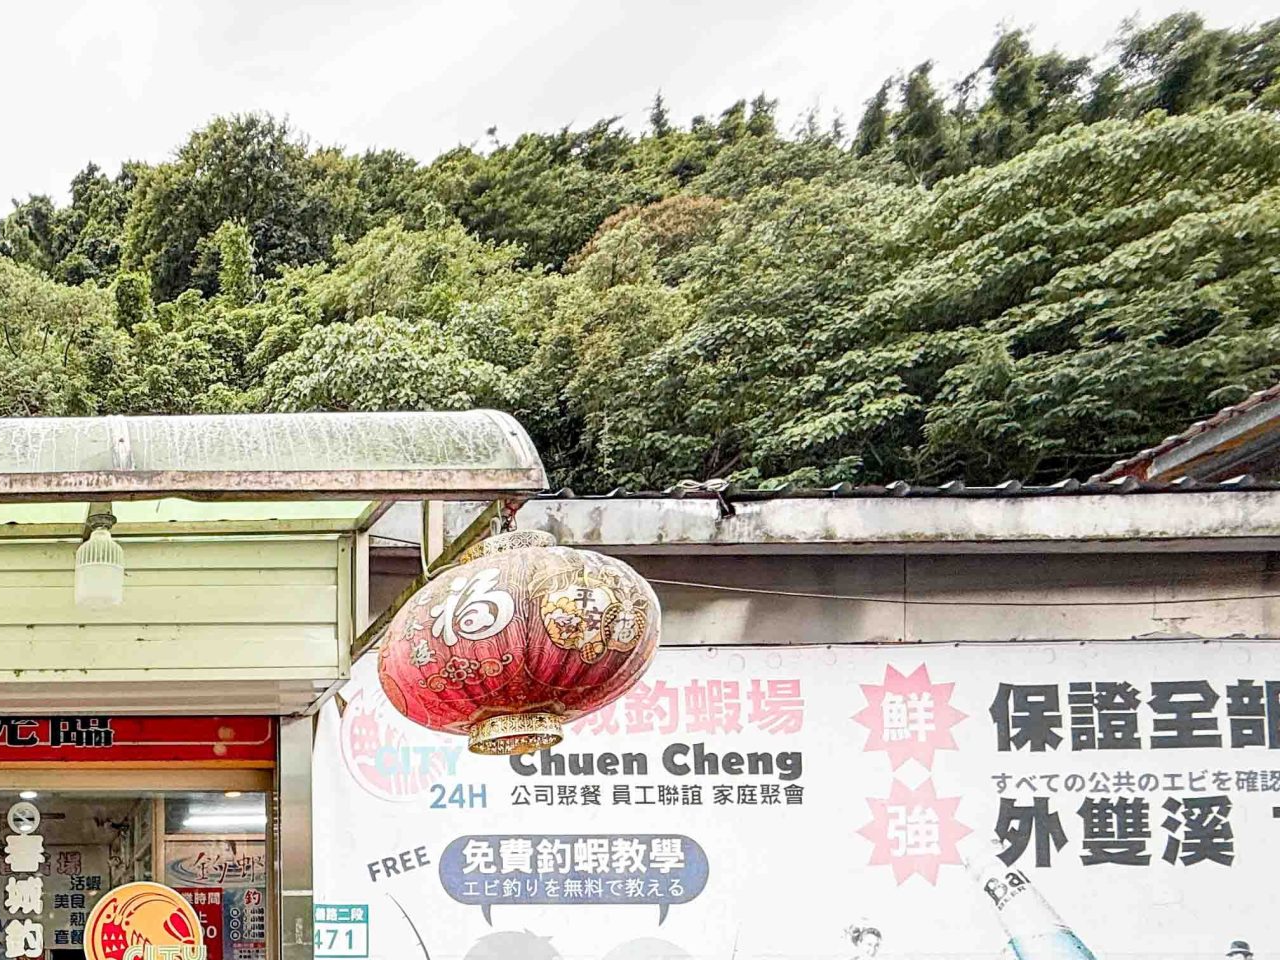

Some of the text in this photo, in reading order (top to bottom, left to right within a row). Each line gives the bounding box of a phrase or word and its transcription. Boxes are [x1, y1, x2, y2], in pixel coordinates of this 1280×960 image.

[430, 567, 515, 647] 福
[880, 692, 936, 743] 鮮
[374, 746, 463, 777] CITY
[509, 743, 803, 782] Chuen Cheng
[429, 783, 488, 809] 24H
[510, 784, 805, 806] 公司聚餐 員工聯誼 家庭聚會
[887, 805, 941, 857] 強
[994, 795, 1234, 868] 外雙溪
[367, 845, 432, 883] FREE
[462, 837, 686, 874] 免費釣蝦教學
[463, 877, 685, 898] エビ釣りを無料で教える
[314, 929, 353, 950] 471
